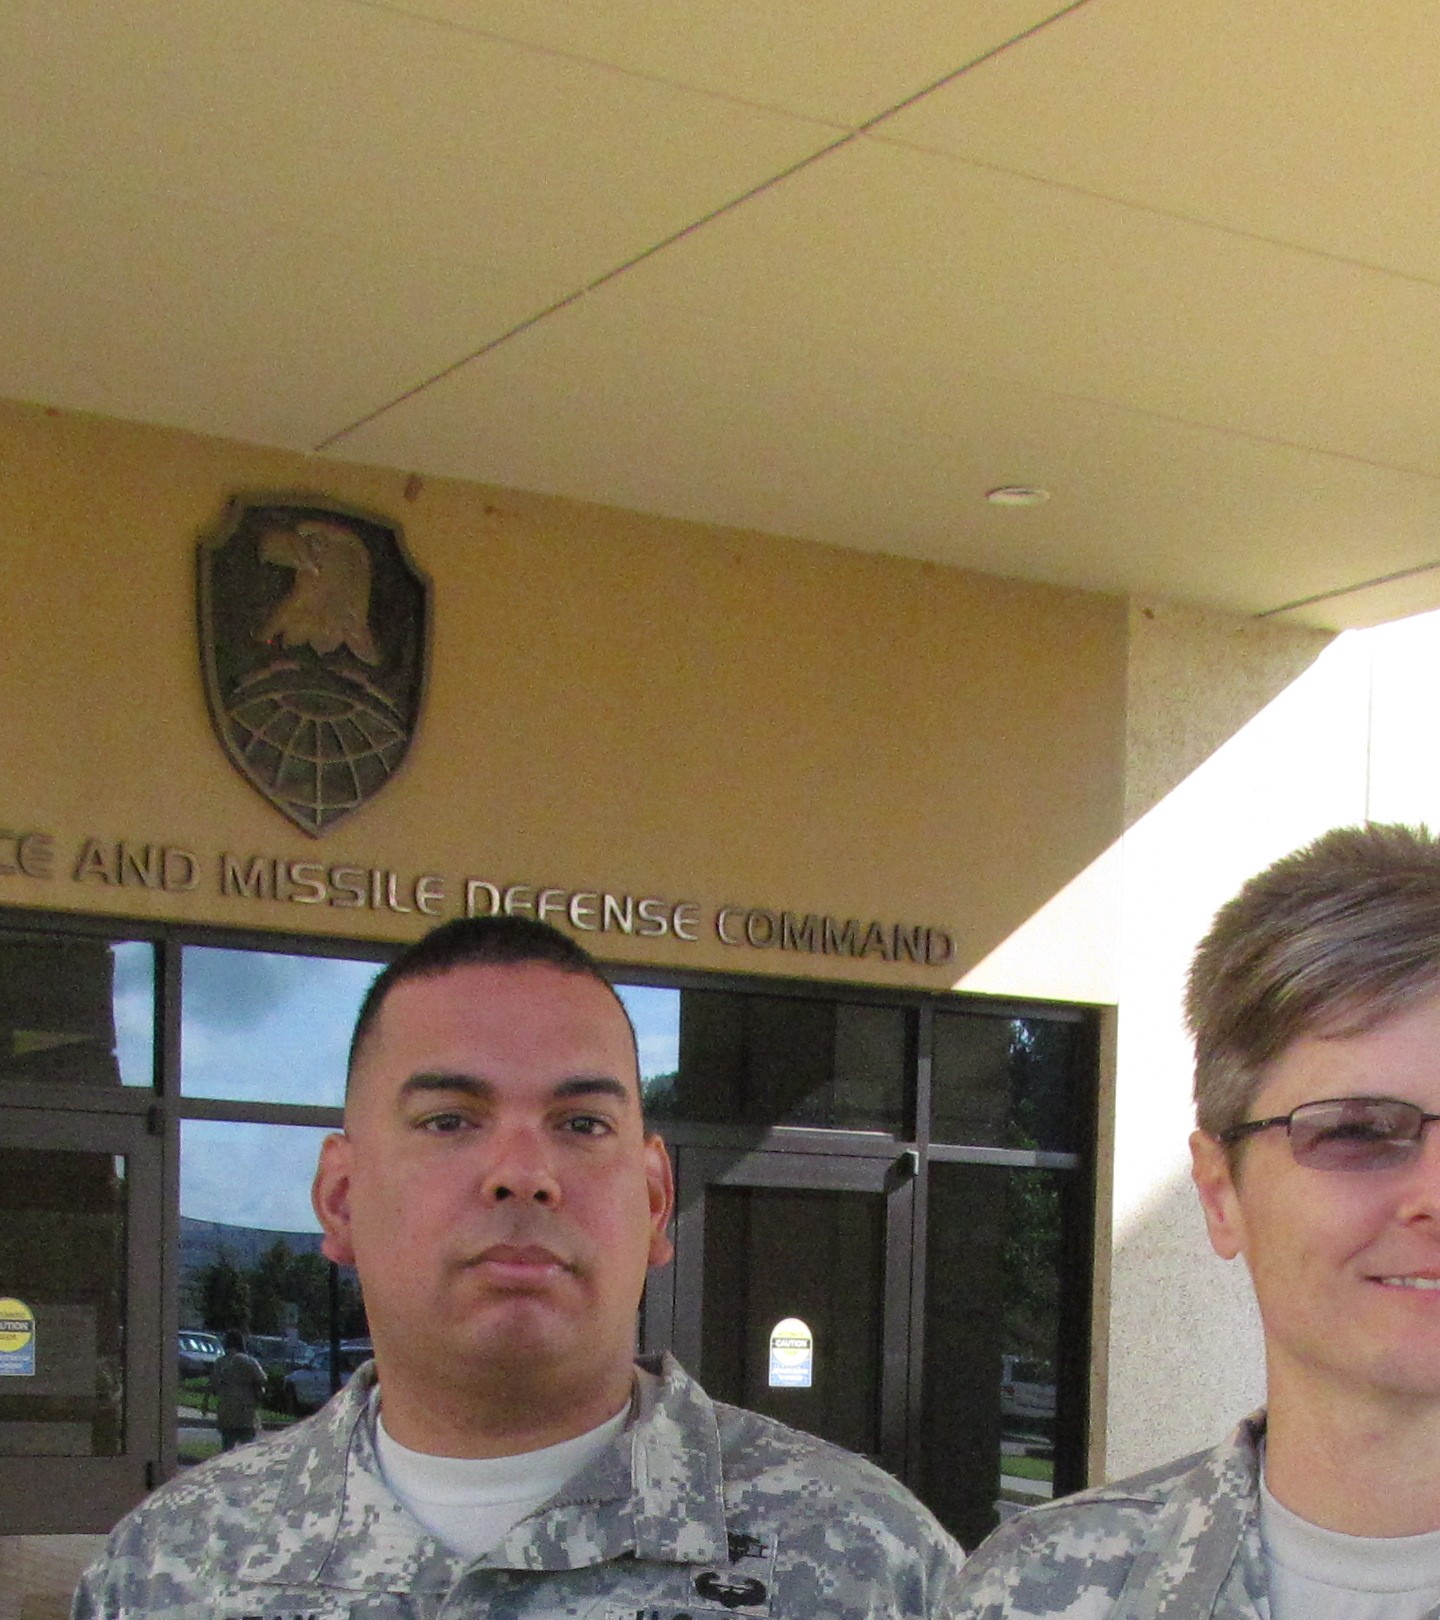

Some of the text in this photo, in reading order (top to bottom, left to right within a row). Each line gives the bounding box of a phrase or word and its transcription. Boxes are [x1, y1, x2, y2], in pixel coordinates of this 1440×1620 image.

[72, 837, 201, 892] AND
[220, 853, 445, 916] MISSILE
[465, 878, 701, 942] DEFENSE
[715, 903, 958, 966] COMMAND
[775, 1338, 808, 1348] CAUTION
